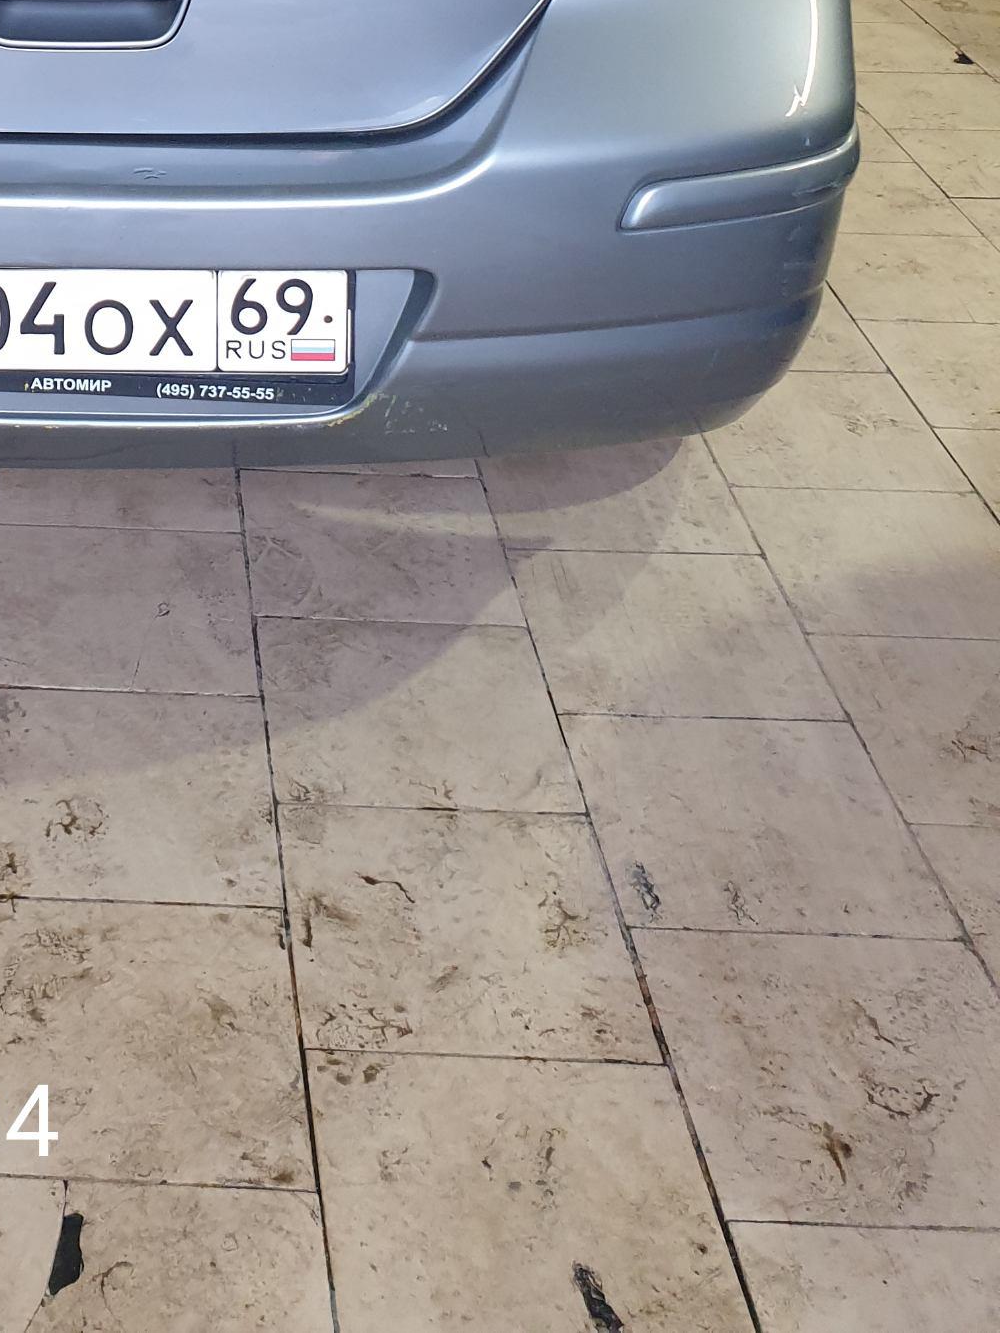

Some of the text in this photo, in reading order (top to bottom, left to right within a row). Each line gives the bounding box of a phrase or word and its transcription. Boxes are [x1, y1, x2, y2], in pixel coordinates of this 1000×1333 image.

[230, 278, 314, 336] 69
[226, 340, 286, 360] RUS
[30, 377, 112, 392] АВТОМИР
[156, 382, 275, 401] (495) 737-55-55
